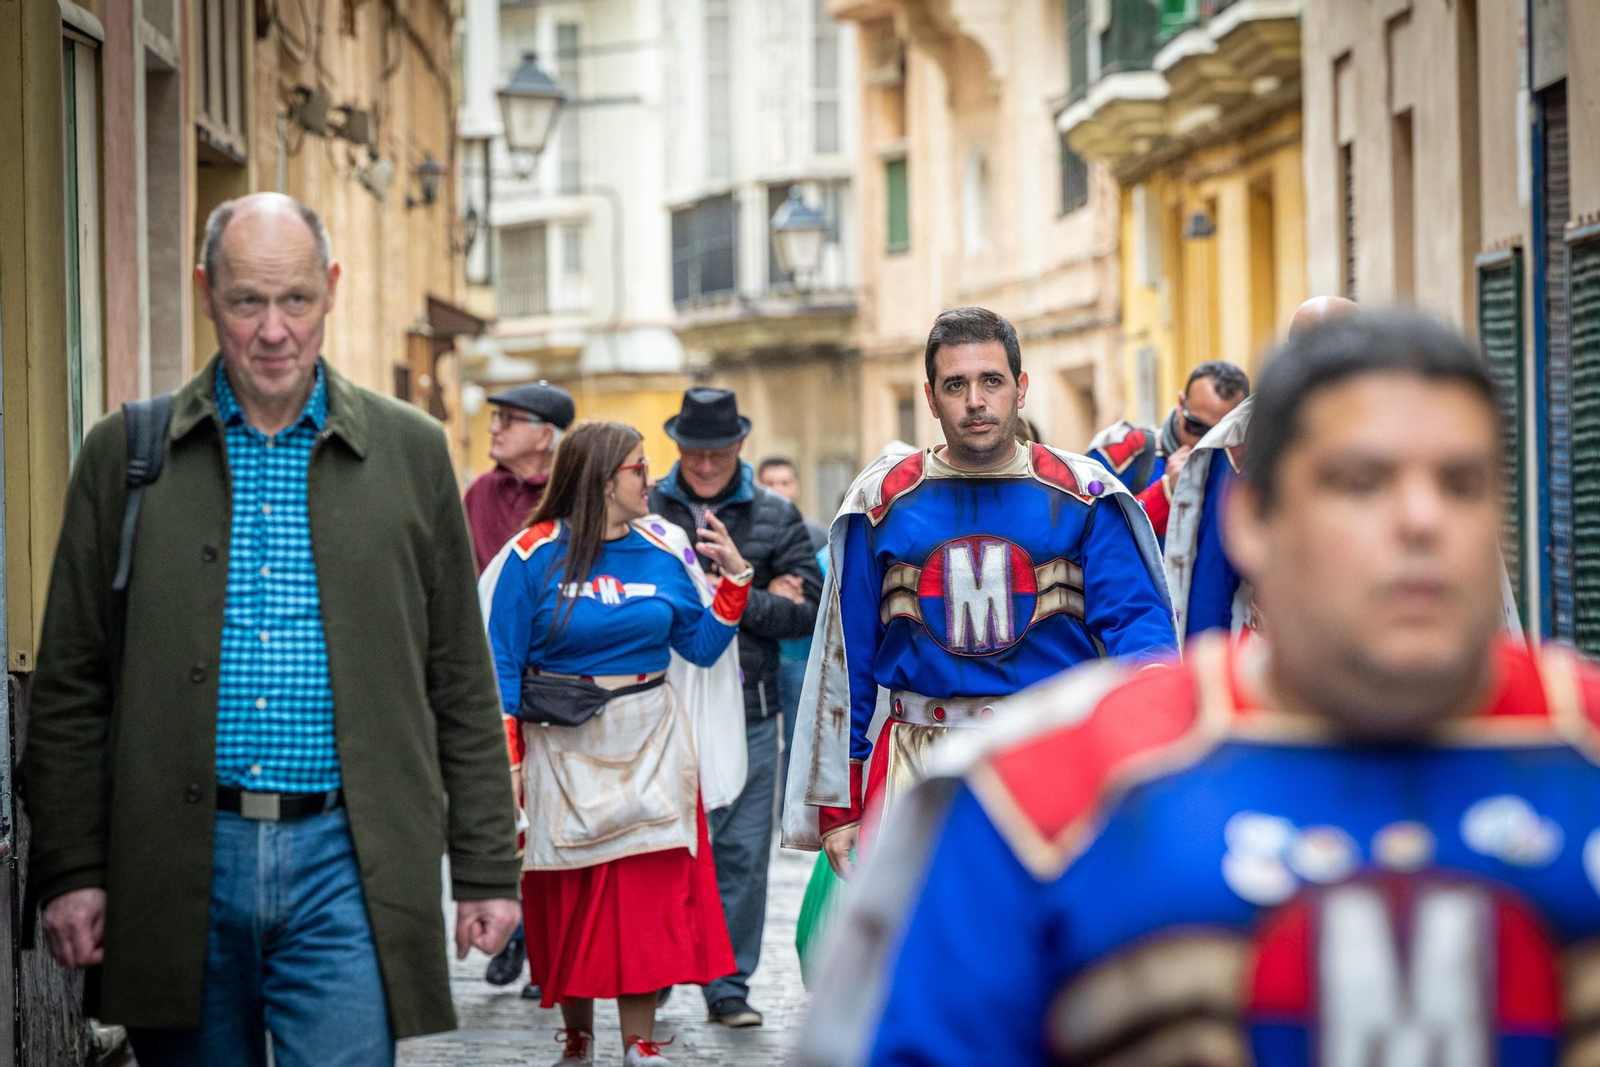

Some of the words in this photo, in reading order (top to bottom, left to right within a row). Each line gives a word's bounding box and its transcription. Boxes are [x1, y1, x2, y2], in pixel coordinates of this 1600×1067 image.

[598, 577, 621, 605] M
[944, 542, 1015, 652] M
[1317, 883, 1492, 1067] M
